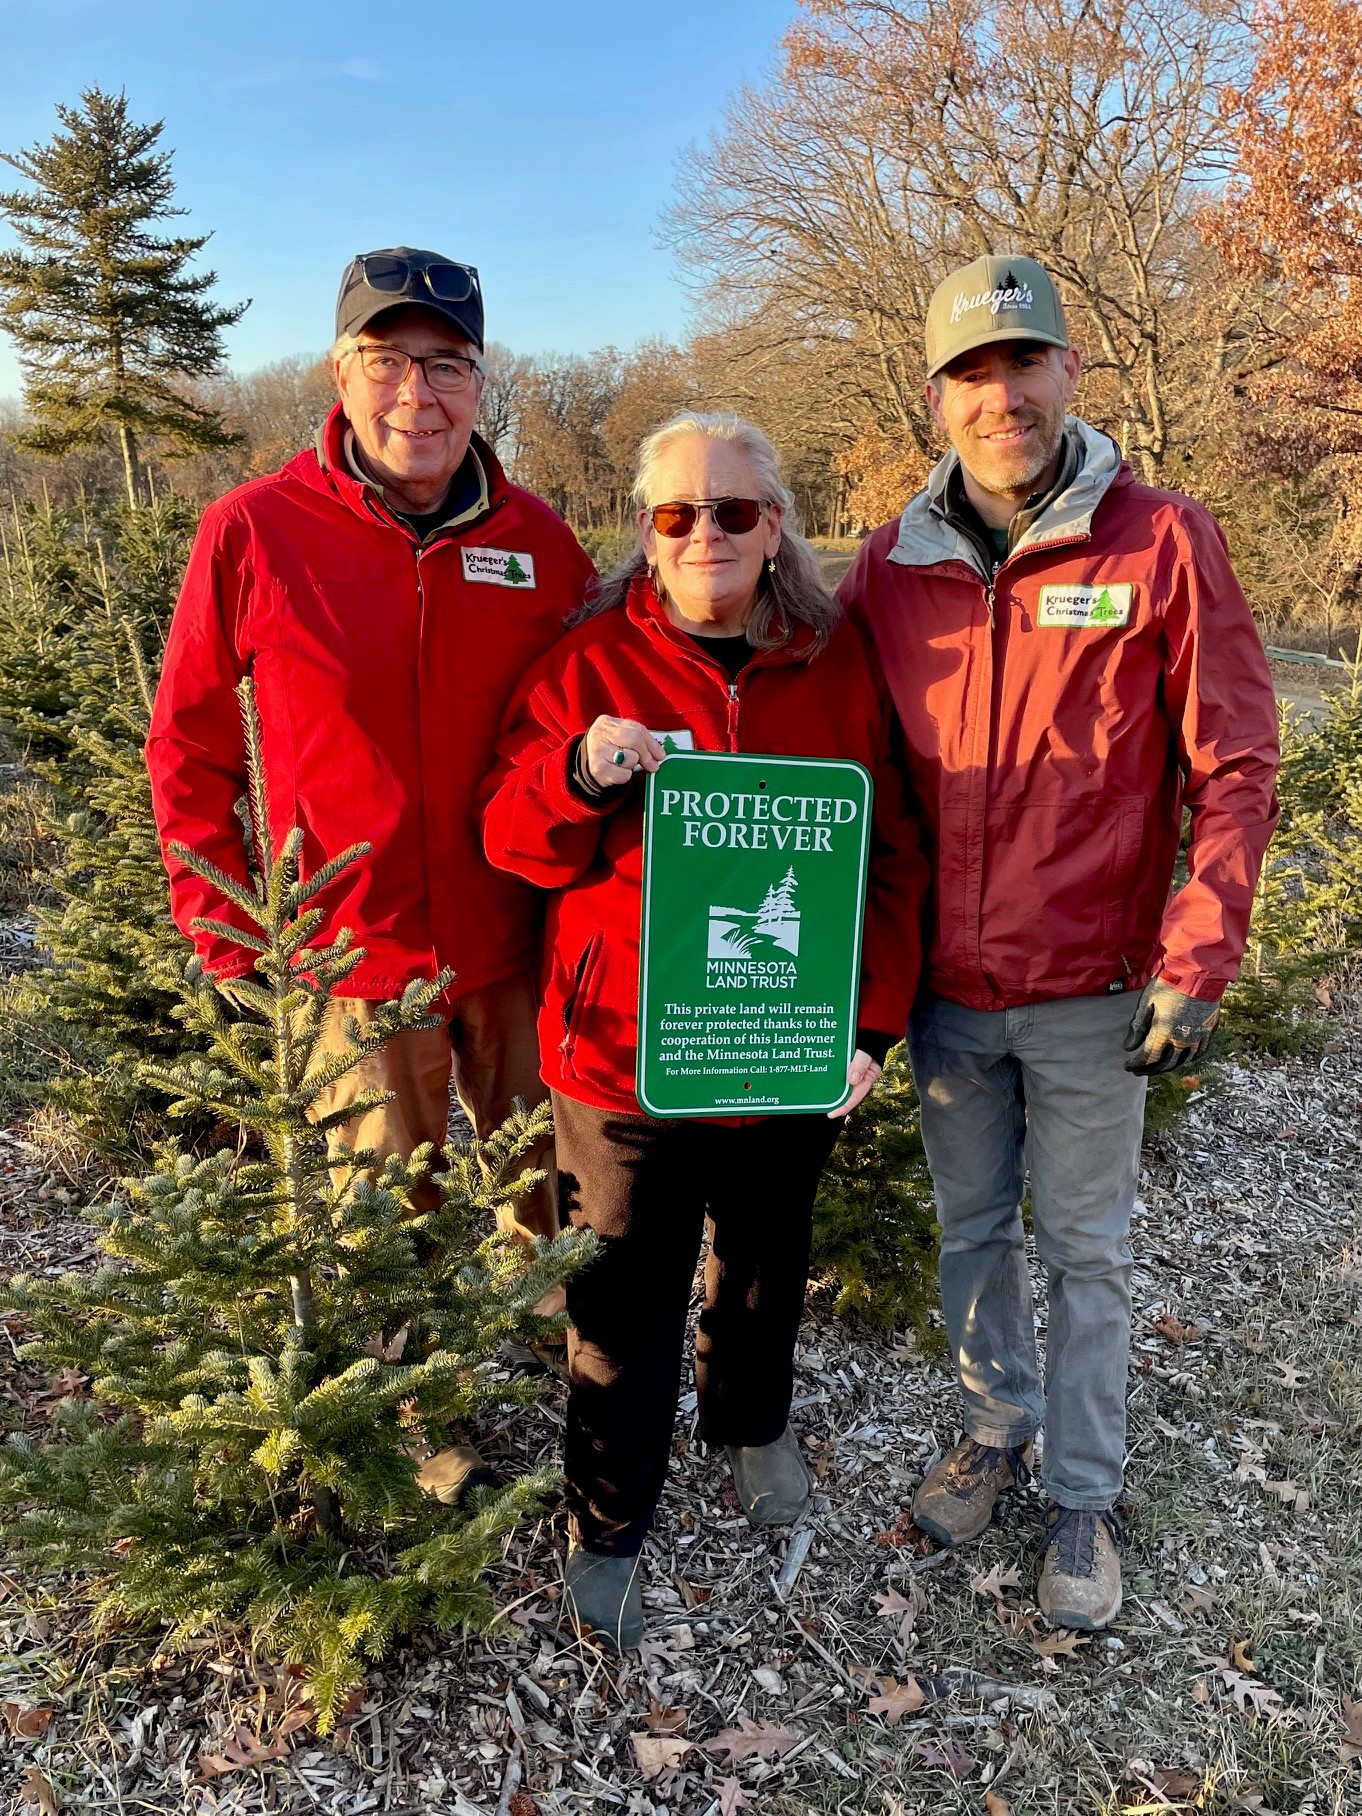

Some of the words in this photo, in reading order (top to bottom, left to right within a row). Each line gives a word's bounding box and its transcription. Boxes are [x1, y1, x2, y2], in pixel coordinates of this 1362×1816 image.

[949, 283, 1034, 324] Krueger's
[465, 553, 508, 566] Krueger's
[468, 564, 507, 577] Christmas
[508, 569, 531, 579] Trees
[1046, 595, 1097, 606] Krueger's
[1046, 606, 1094, 617] Christmas
[1096, 606, 1124, 617] Trees
[660, 789, 858, 823] PROTECTED
[682, 821, 834, 851] FOREVER
[706, 961, 798, 974] MINNESOTA
[706, 975, 748, 989] LAND
[750, 975, 798, 988] TRUST
[664, 1003, 692, 1015] This
[694, 1004, 737, 1018] private
[739, 1003, 766, 1015] land
[768, 1003, 792, 1014] will
[794, 1003, 835, 1015] remain
[659, 1019, 704, 1031] forever
[705, 1018, 761, 1034] protected
[763, 1018, 803, 1030] thanks
[805, 1019, 816, 1029] to
[818, 1017, 838, 1029] the
[660, 1034, 731, 1049] cooperation
[733, 1033, 747, 1046] of
[749, 1033, 771, 1045] this
[773, 1033, 836, 1045] landowner
[659, 1050, 682, 1062] and
[685, 1049, 704, 1061] the
[706, 1048, 769, 1061] Minnesota
[771, 1048, 801, 1060] Land
[803, 1047, 835, 1059] Trust.
[665, 1067, 679, 1076] For
[680, 1067, 701, 1076] More
[702, 1065, 748, 1075] Information
[749, 1065, 768, 1074] Call:
[768, 1064, 828, 1074] 1-877-MLT-Land
[714, 1095, 780, 1106] www.mnland.org
